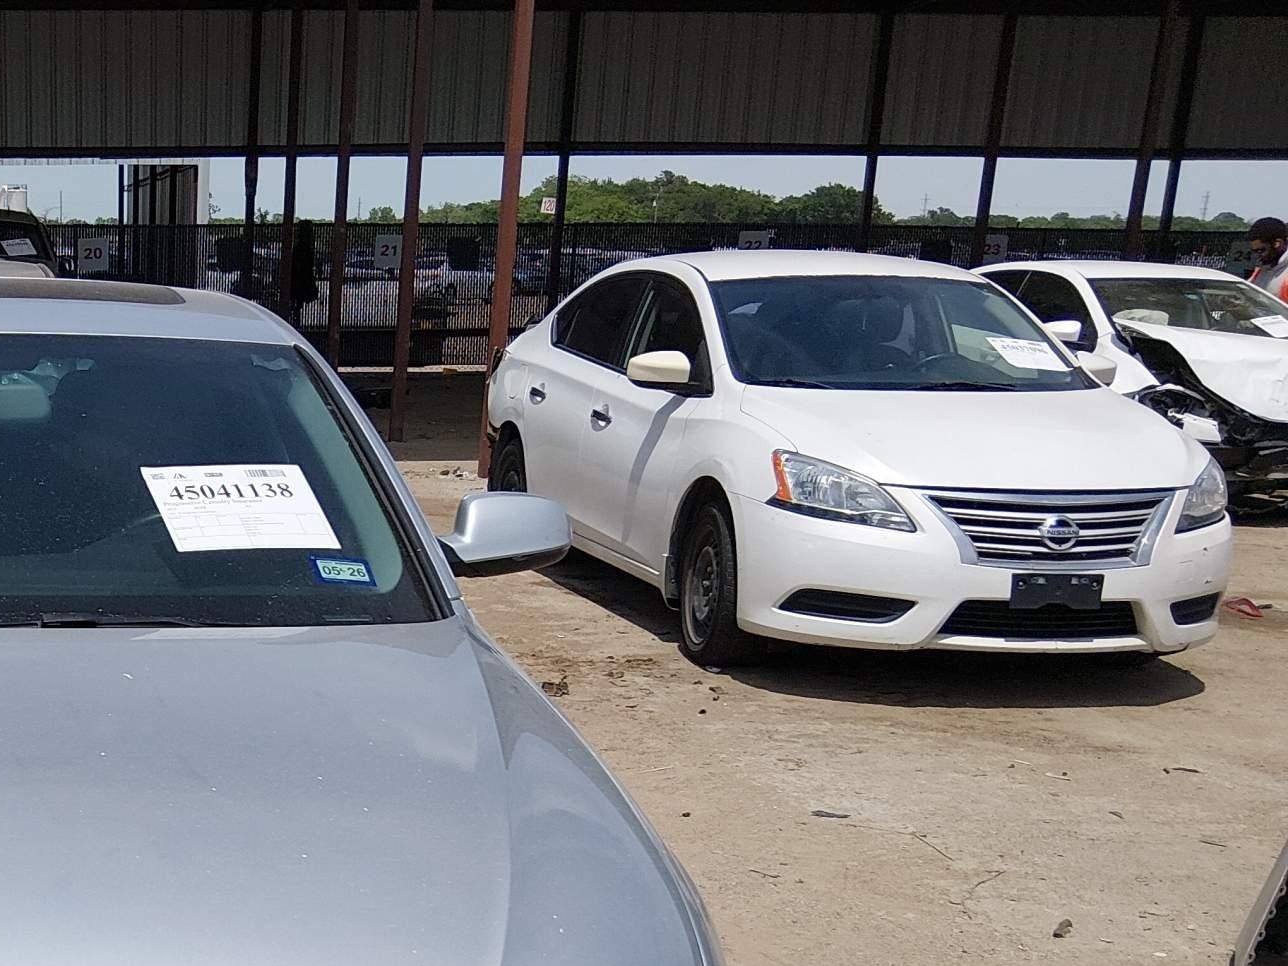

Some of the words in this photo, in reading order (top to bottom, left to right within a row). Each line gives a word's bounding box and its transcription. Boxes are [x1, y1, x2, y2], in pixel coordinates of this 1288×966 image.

[83, 247, 103, 260] 20
[380, 244, 398, 257] 21
[983, 243, 1001, 256] 23
[169, 482, 294, 501] 45041138
[1047, 528, 1079, 536] NISSAN
